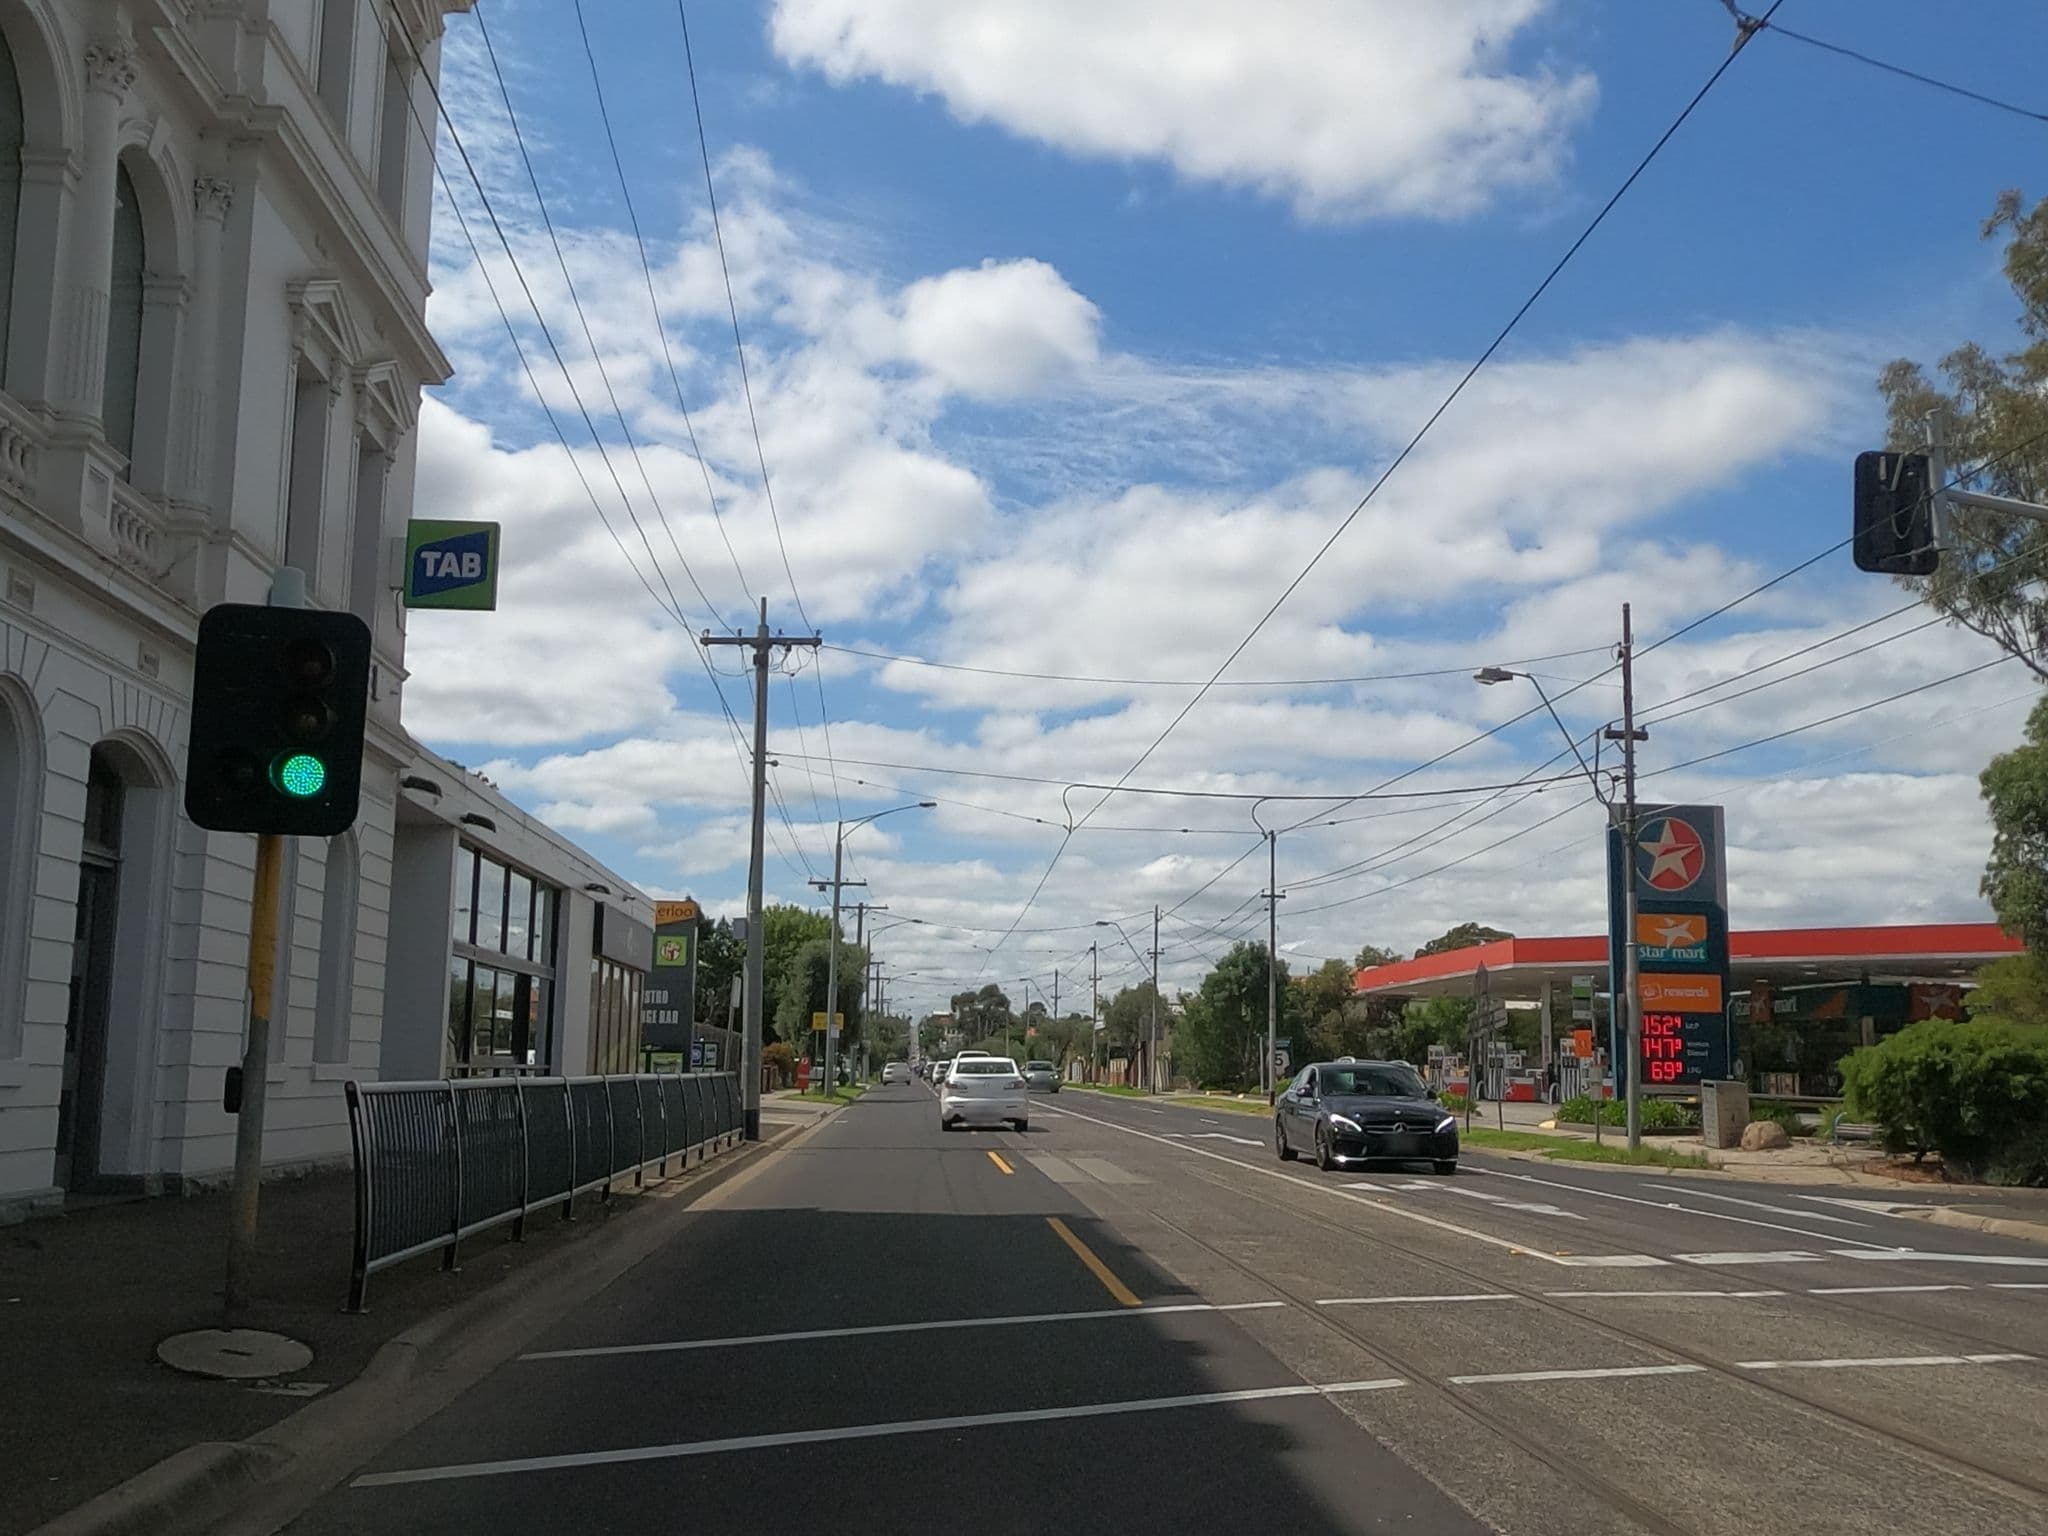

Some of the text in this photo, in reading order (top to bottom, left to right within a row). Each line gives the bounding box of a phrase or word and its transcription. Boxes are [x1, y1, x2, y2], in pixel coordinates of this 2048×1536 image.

[420, 551, 481, 578] TAB
[1639, 945, 1705, 959] star mart
